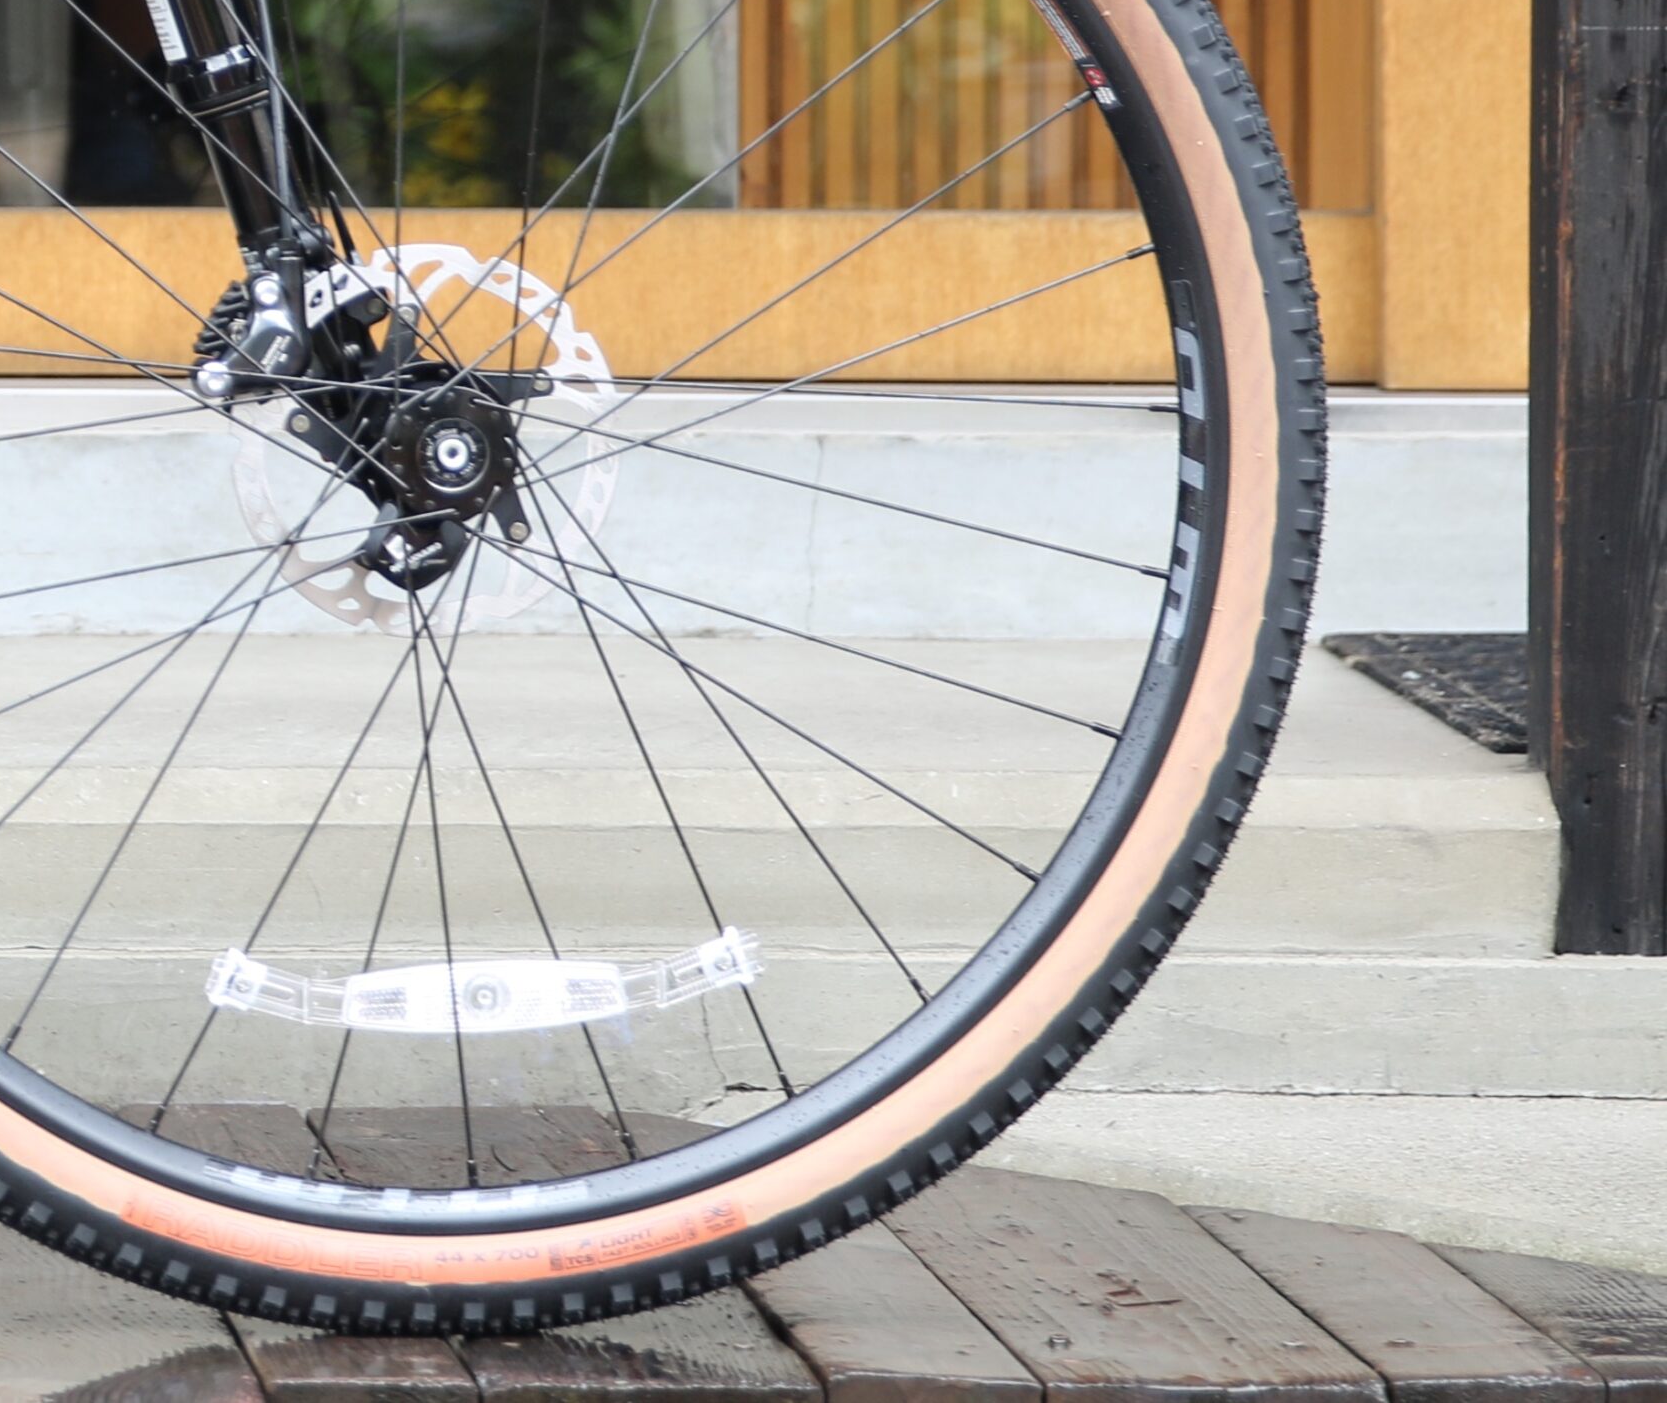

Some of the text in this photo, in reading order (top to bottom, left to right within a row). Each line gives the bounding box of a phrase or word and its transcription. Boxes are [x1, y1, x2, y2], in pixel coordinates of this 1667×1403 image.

[600, 1228, 653, 1249] LIGHT
[435, 1250, 465, 1265] 44
[495, 1247, 540, 1263] 700
